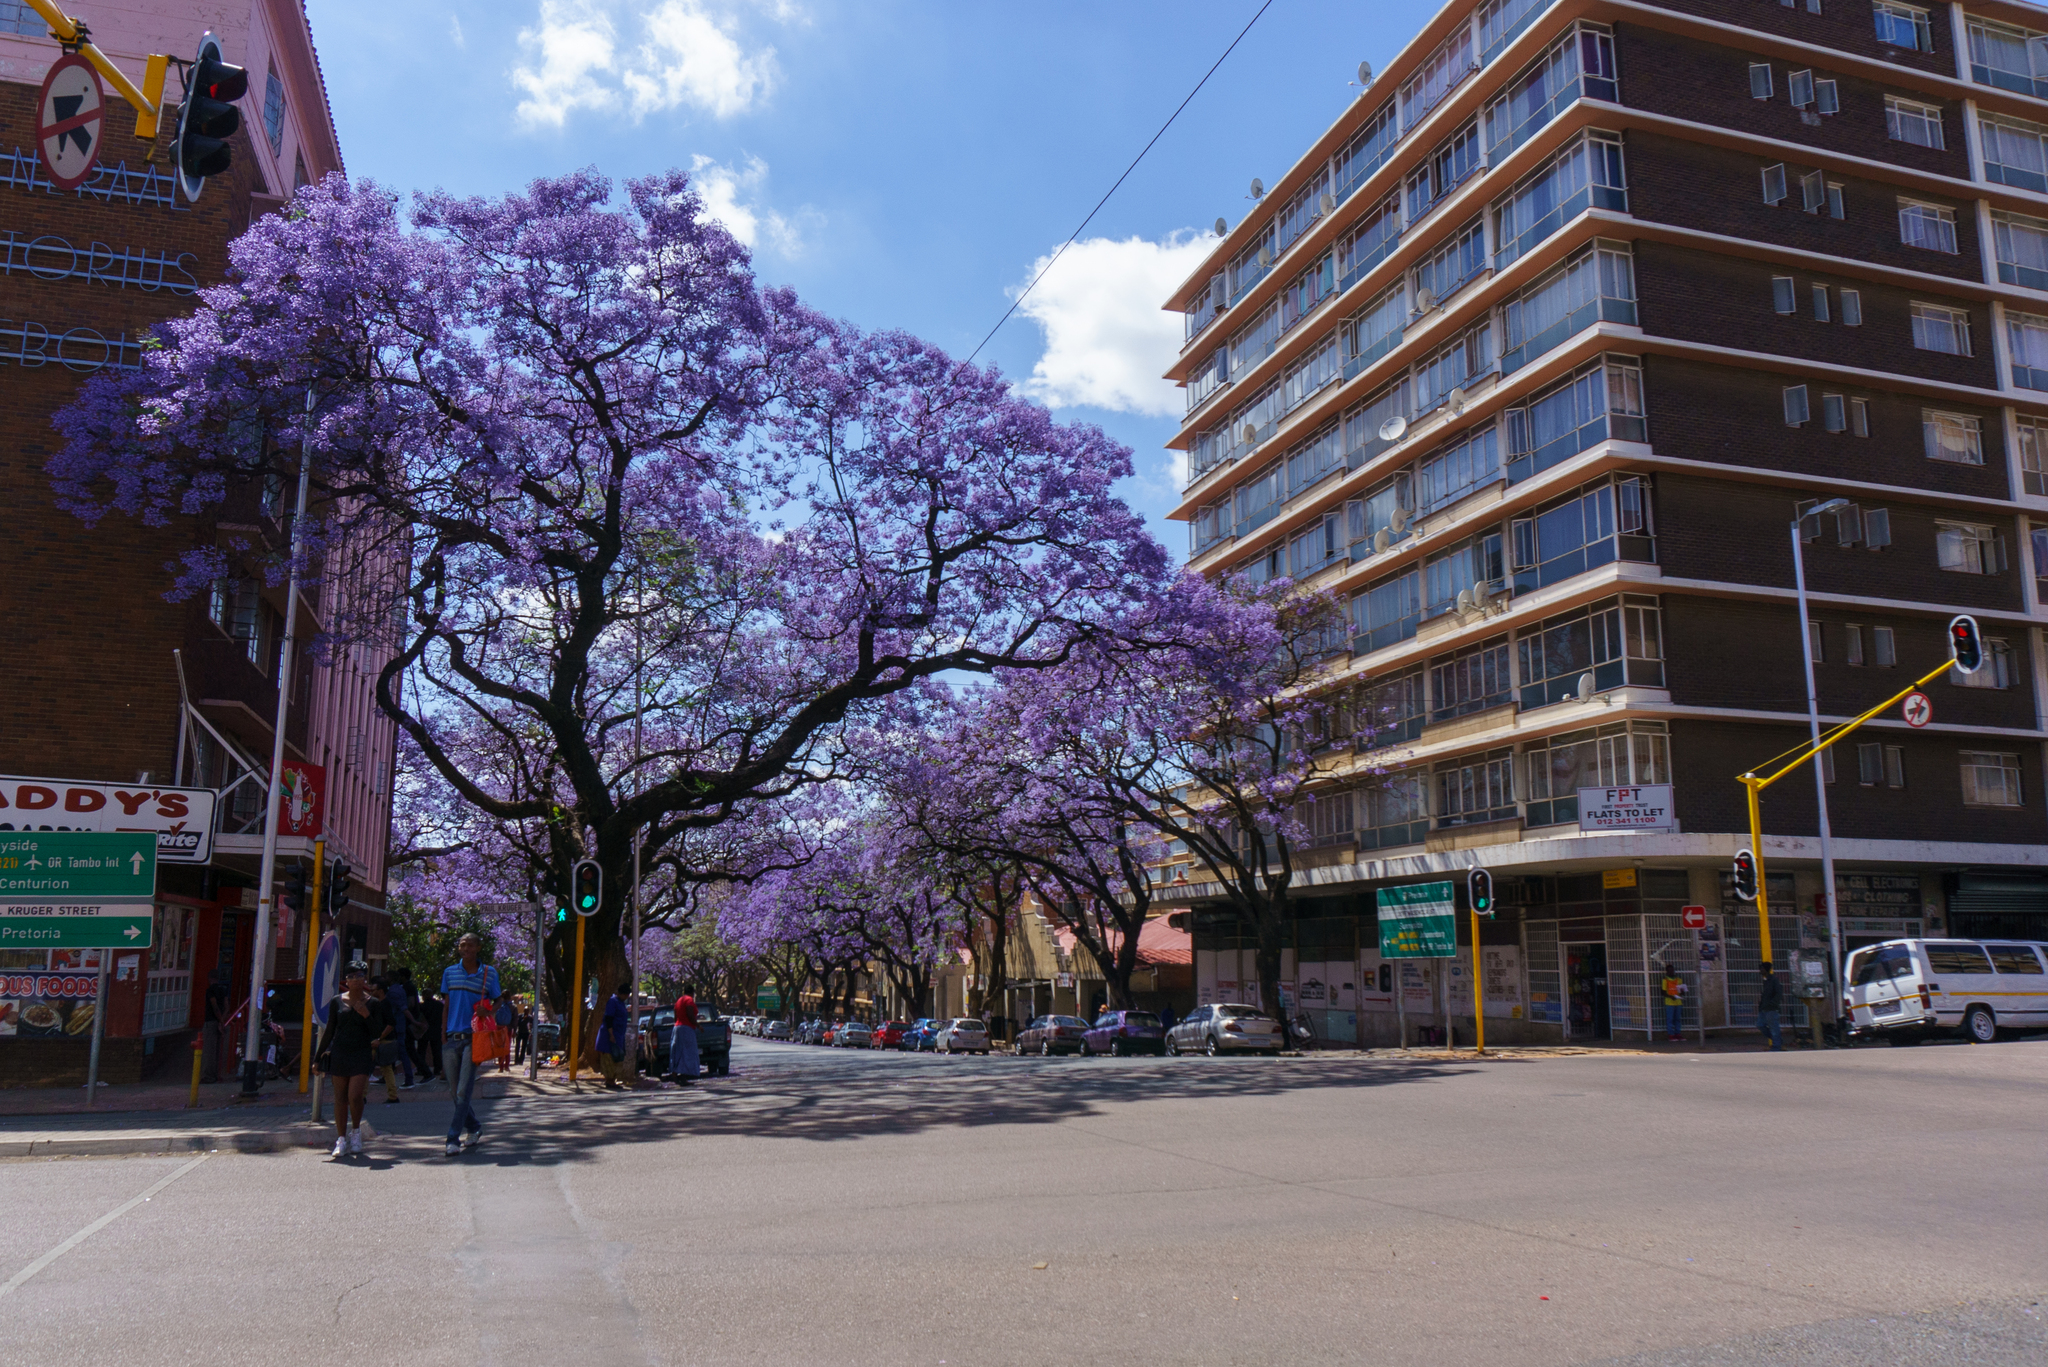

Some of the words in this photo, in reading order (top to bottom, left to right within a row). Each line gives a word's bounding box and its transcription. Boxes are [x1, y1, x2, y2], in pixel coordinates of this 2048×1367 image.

[2, 229, 199, 296] TORIUS
[1606, 788, 1641, 802] FPT
[1587, 810, 1622, 818] FLATS
[1624, 809, 1639, 817] TO
[1643, 808, 1664, 816] LET
[48, 857, 62, 868] OR
[68, 857, 101, 868] Tambo
[0, 878, 69, 889] Centurion
[8, 906, 53, 915] KRUGER
[59, 906, 101, 915] STREET
[3, 927, 61, 938] Pretoria
